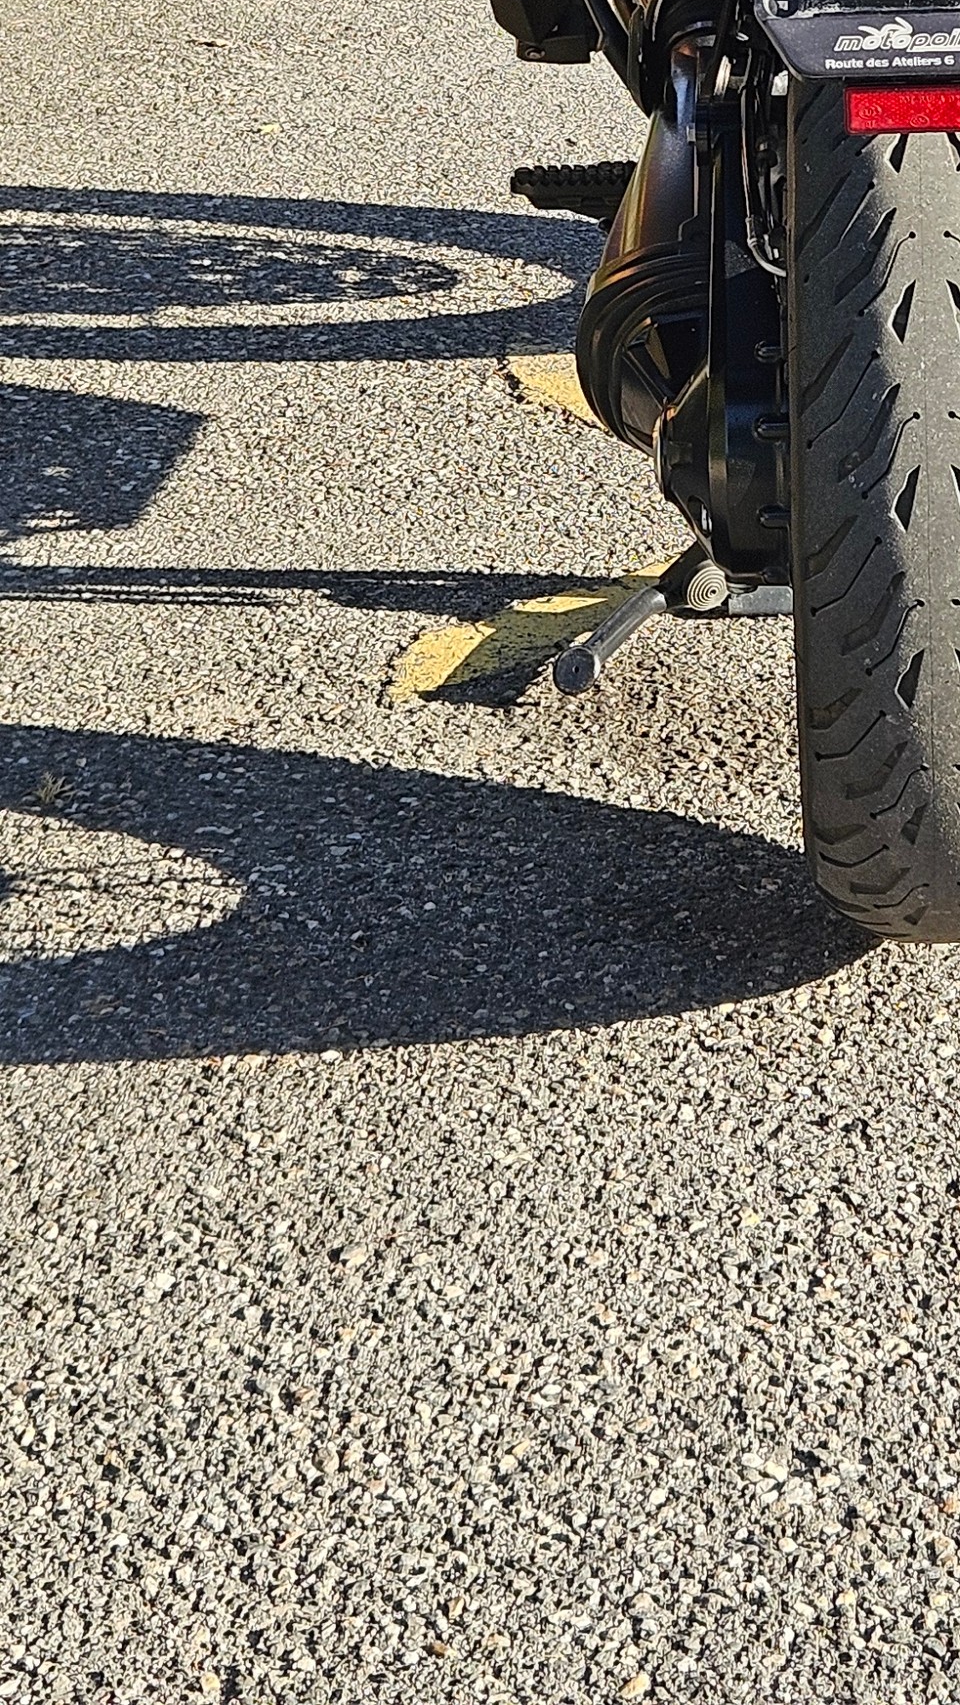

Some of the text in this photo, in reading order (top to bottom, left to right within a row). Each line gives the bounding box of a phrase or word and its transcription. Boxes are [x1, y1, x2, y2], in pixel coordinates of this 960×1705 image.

[825, 58, 864, 69] Route
[866, 57, 890, 68] des
[892, 56, 943, 67] Ateliers
[943, 55, 955, 66] 6
